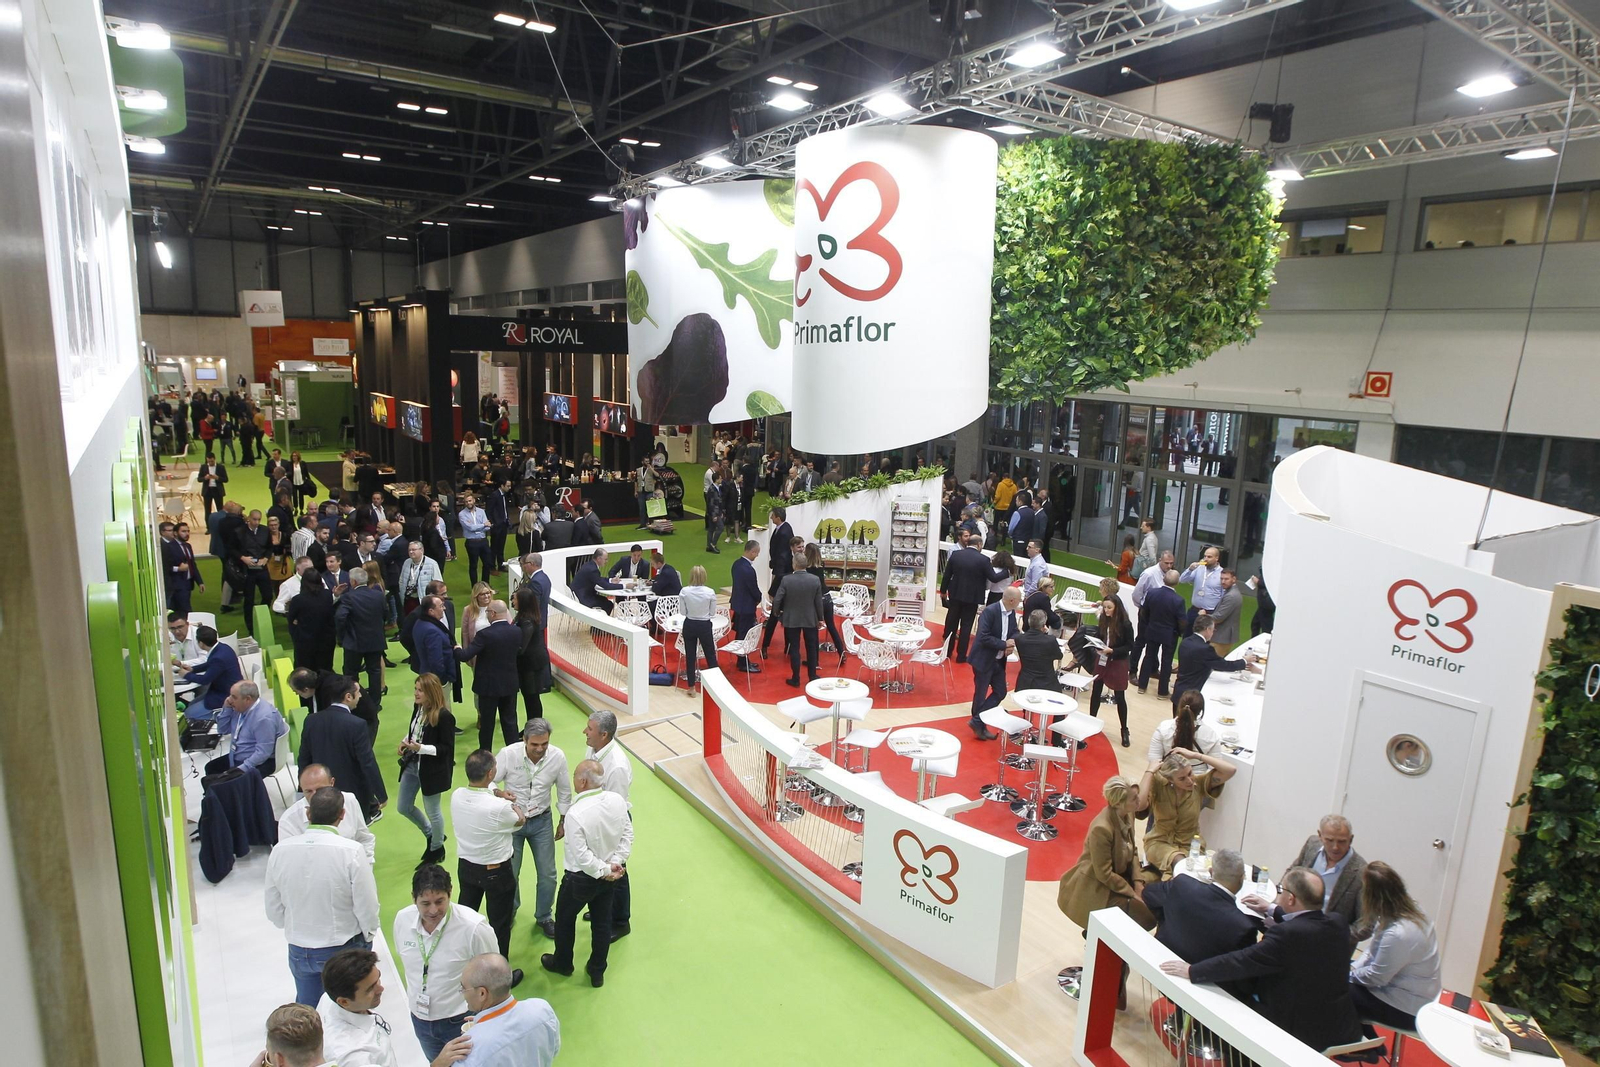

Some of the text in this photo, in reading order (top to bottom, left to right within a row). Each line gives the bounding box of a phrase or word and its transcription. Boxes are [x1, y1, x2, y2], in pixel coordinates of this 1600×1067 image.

[530, 327, 584, 344] ROYAL
[794, 316, 896, 345] Primaflor
[1391, 644, 1466, 673] Primaflor
[899, 889, 954, 923] Primaflor
